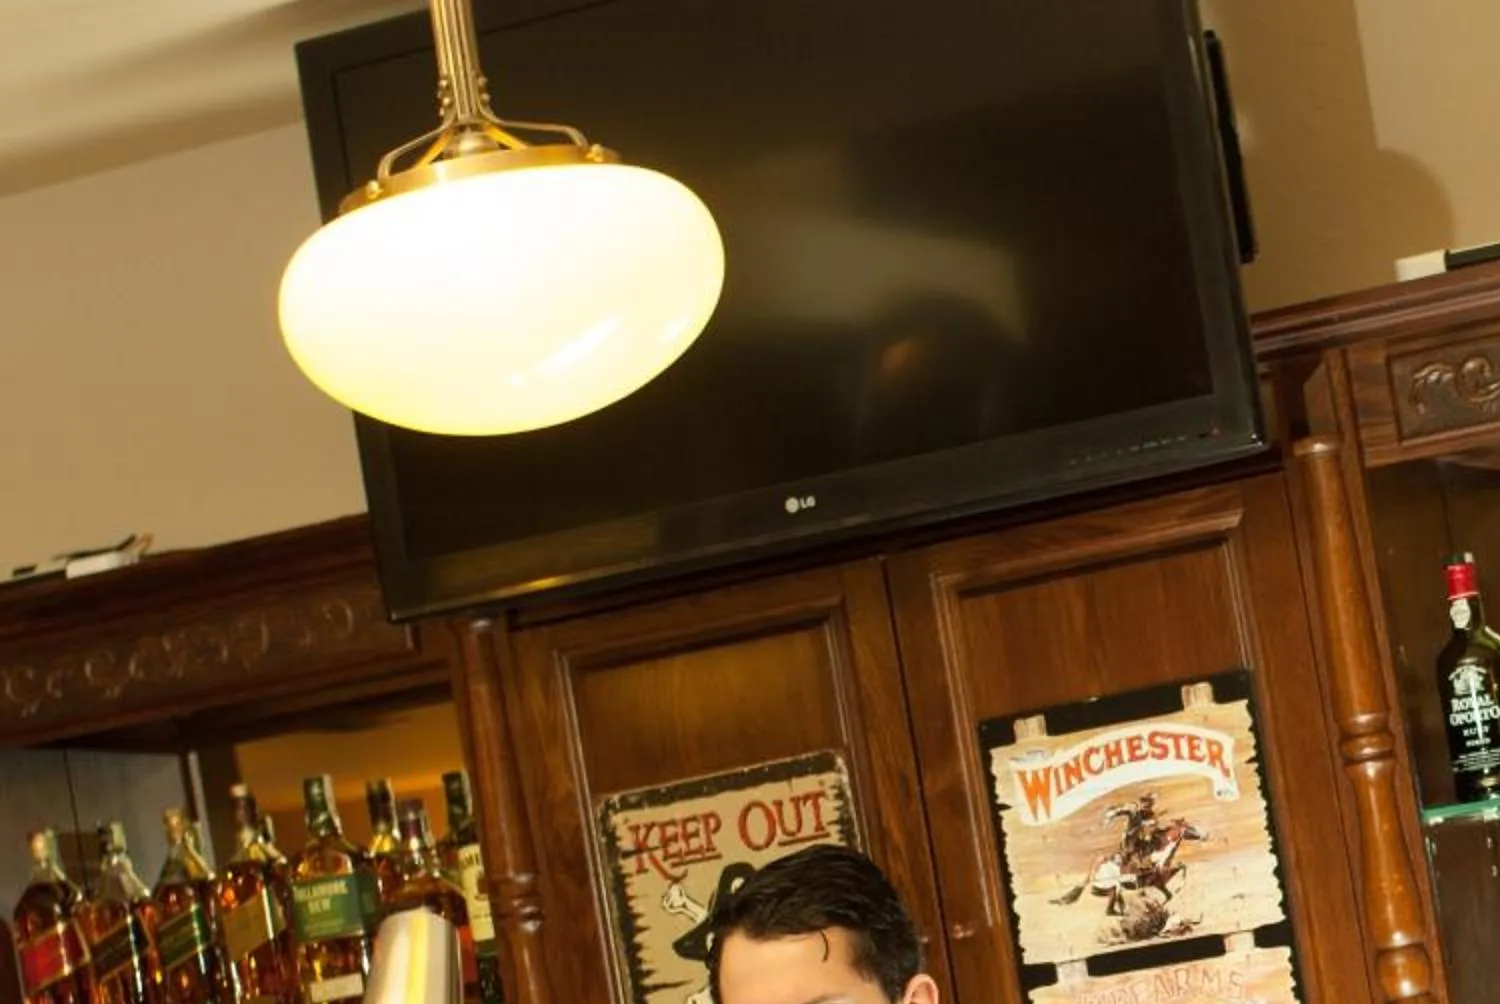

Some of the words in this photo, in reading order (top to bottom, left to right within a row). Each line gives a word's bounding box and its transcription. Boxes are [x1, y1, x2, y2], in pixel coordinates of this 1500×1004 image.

[1016, 729, 1231, 822] WINCHESTER
[627, 810, 722, 882] KEEP
[738, 789, 830, 851] OUT
